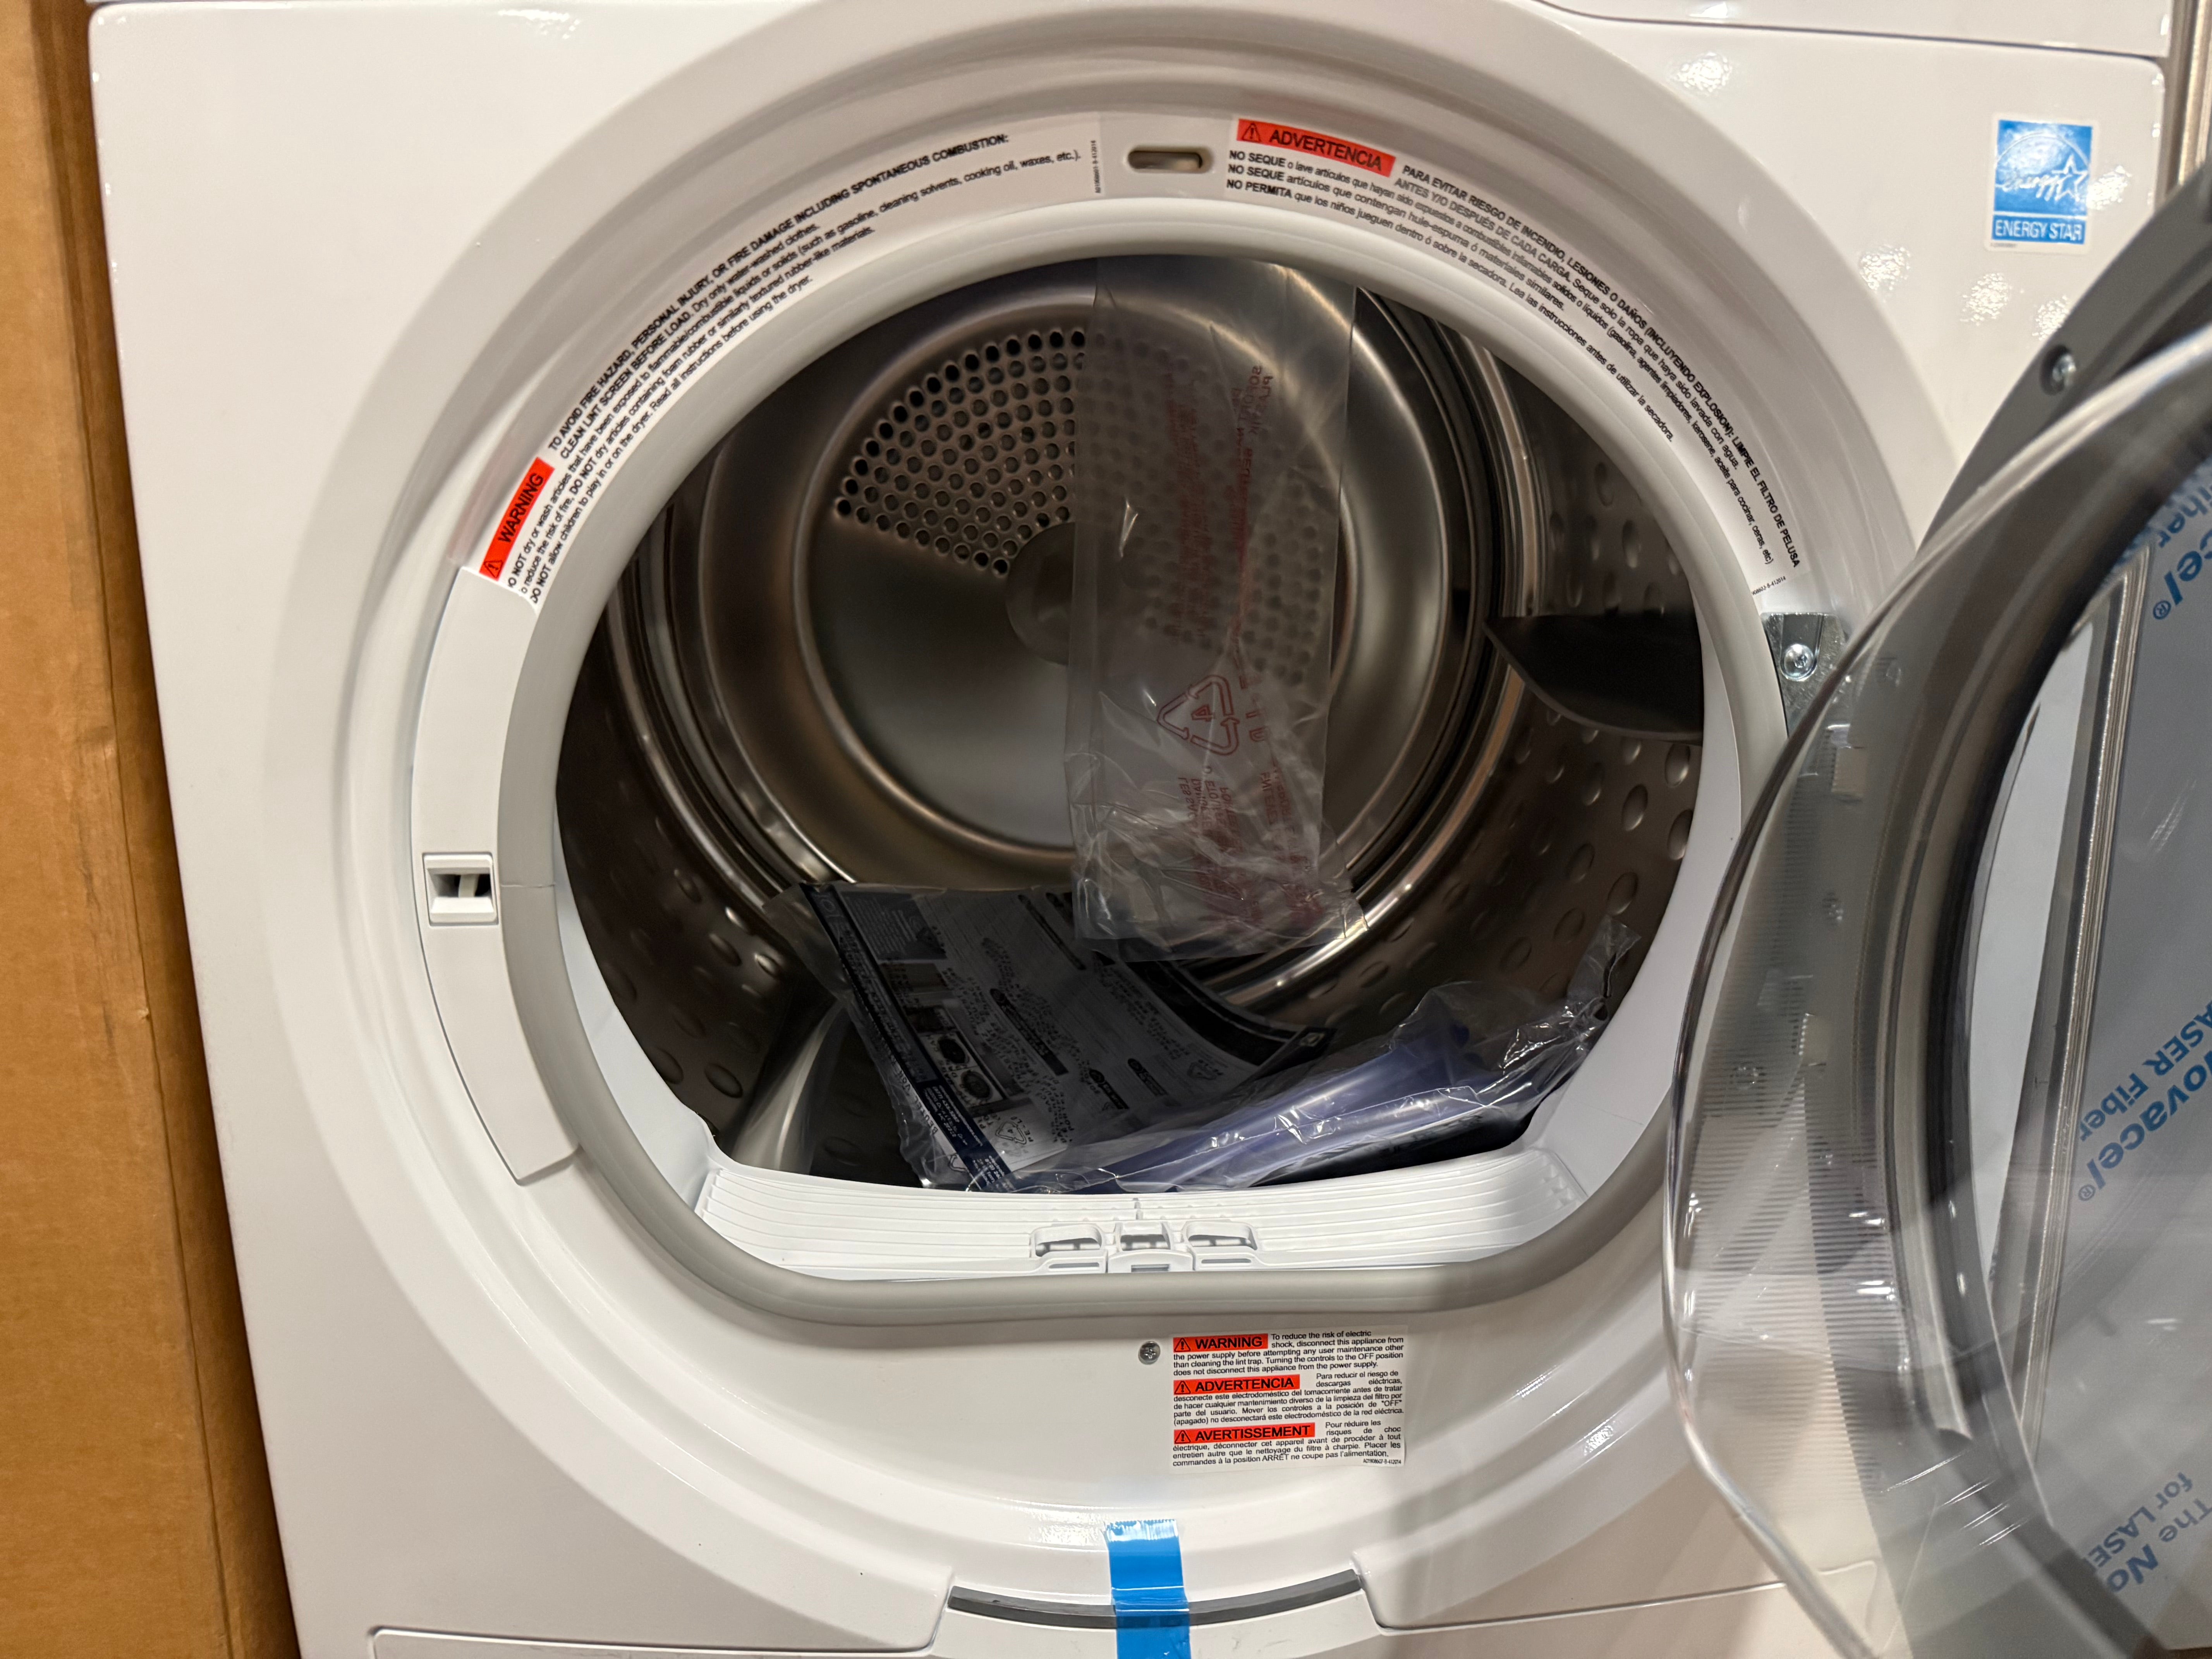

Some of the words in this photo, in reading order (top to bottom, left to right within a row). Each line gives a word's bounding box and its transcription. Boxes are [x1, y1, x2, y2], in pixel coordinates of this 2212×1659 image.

[1269, 129, 1382, 171] ADVERTENCIA
[1995, 220, 2049, 238] ENERGY
[2049, 222, 2083, 240] STAR
[548, 436, 562, 450] TO
[559, 407, 582, 438] AVOID
[579, 385, 600, 409] FIRE
[596, 349, 635, 388] HAZARD,
[631, 305, 680, 349] PERSONAL
[677, 275, 714, 306] INJURY,
[712, 263, 729, 278] OR
[726, 246, 751, 267] FIRE
[749, 218, 795, 251] DAMAGE
[793, 189, 850, 223] INCLUDING
[850, 155, 930, 194] SPONTANEOUS
[932, 134, 1009, 161] COMBUSTION:
[1226, 179, 1242, 189] NO
[1245, 181, 1292, 198] PERMITA
[1294, 193, 1312, 203] que
[1314, 196, 1328, 207] los
[1330, 201, 1355, 215] niños
[1355, 208, 1393, 228] jueguen
[1395, 223, 1424, 241] dentro
[1425, 236, 1432, 244] ó
[1432, 241, 1457, 258] sobre
[1458, 252, 1467, 263] la
[1467, 259, 1506, 287] secadora.
[1509, 282, 1525, 299] Lea
[1525, 294, 1538, 307] las
[1538, 303, 1587, 346] instrucciones
[1586, 345, 1607, 364] antes
[1606, 364, 1617, 374] de
[1616, 373, 1639, 397] utilizar
[1637, 395, 1645, 406] la
[1644, 405, 1673, 442] secadora.
[560, 426, 586, 459] CLEAN
[582, 404, 601, 427] LINT
[599, 368, 633, 406] SCREEN
[630, 333, 667, 370] BEFORE
[664, 311, 694, 337] LOAD.
[691, 297, 709, 313] Dry
[708, 283, 726, 299] only
[725, 241, 785, 285] water-washed
[785, 223, 821, 246] clothes.
[1402, 165, 1429, 184] PARA
[1431, 177, 1468, 201] EVITAR
[1468, 195, 1506, 220] RIESGO
[1505, 216, 1522, 230] DE
[1520, 225, 1565, 262] INCENDIO,
[1566, 257, 1610, 295] LESIONES
[1609, 292, 1618, 302] O
[1616, 299, 1647, 329] DAÑOS
[1644, 327, 1695, 382] (INCLUYENDO
[1693, 381, 1734, 437] EXPLOSION):
[1731, 436, 1754, 468] LIMPIE
[1750, 467, 1760, 481] EL
[1757, 480, 1778, 513] FILTRO
[1773, 514, 1785, 529] DE
[1780, 528, 1800, 568] PELUSA
[536, 563, 551, 587] NOT
[548, 541, 563, 565] allow
[560, 507, 582, 541] children
[578, 497, 588, 506] to
[586, 477, 601, 498] play
[596, 469, 607, 478] in
[605, 458, 613, 469] or
[612, 447, 623, 459] on
[619, 433, 633, 447] the
[632, 411, 653, 433] dryer.
[649, 387, 672, 411] Read
[670, 378, 681, 390] all
[678, 340, 723, 380] instructions
[721, 319, 749, 342] before
[749, 301, 773, 321] using
[771, 291, 787, 304] the
[787, 275, 813, 294] dryer.
[498, 473, 543, 543] WARNING
[2079, 1073, 2149, 1142] Fiber
[1195, 1336, 1262, 1350] WARNING
[1212, 1351, 1235, 1359] supply
[1352, 1338, 1386, 1346] appliance
[1376, 1352, 1403, 1360] position
[1195, 1377, 1294, 1392] ADVERTENCIA
[1262, 1365, 1296, 1373] appliance
[1195, 1425, 1310, 1441] AVERTISSEMENT
[2155, 1472, 2193, 1510] for
[2086, 1506, 2157, 1568] LASE
[2159, 1498, 2212, 1542] The
